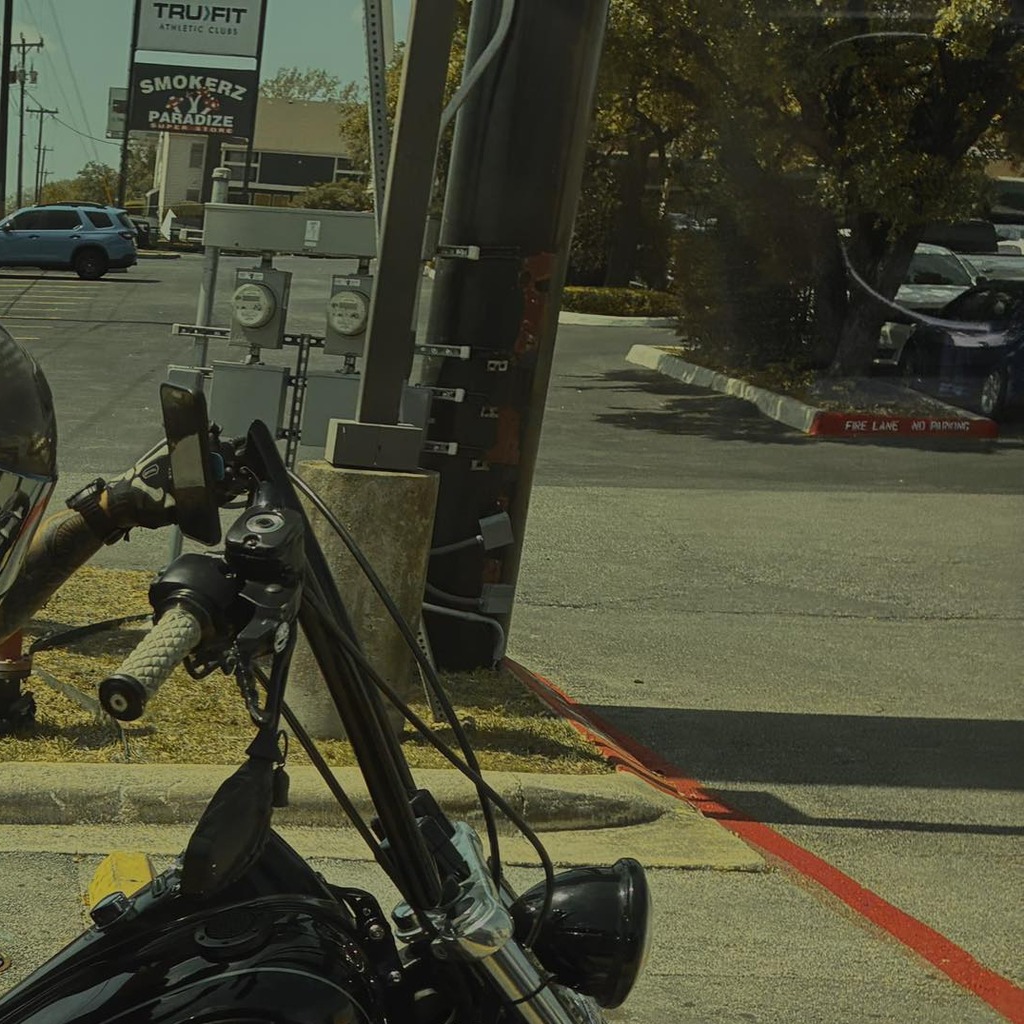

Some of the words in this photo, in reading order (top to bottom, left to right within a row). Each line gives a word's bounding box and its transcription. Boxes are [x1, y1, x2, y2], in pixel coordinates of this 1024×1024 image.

[159, 24, 203, 33] ATHLETIC
[209, 26, 238, 35] CLUBS
[139, 75, 247, 101] SMOKERZ
[148, 111, 234, 128] PARADIZE
[844, 420, 867, 432] FIRE
[872, 420, 899, 432] LANE
[911, 420, 926, 432] NO
[930, 421, 970, 432] PARKING
